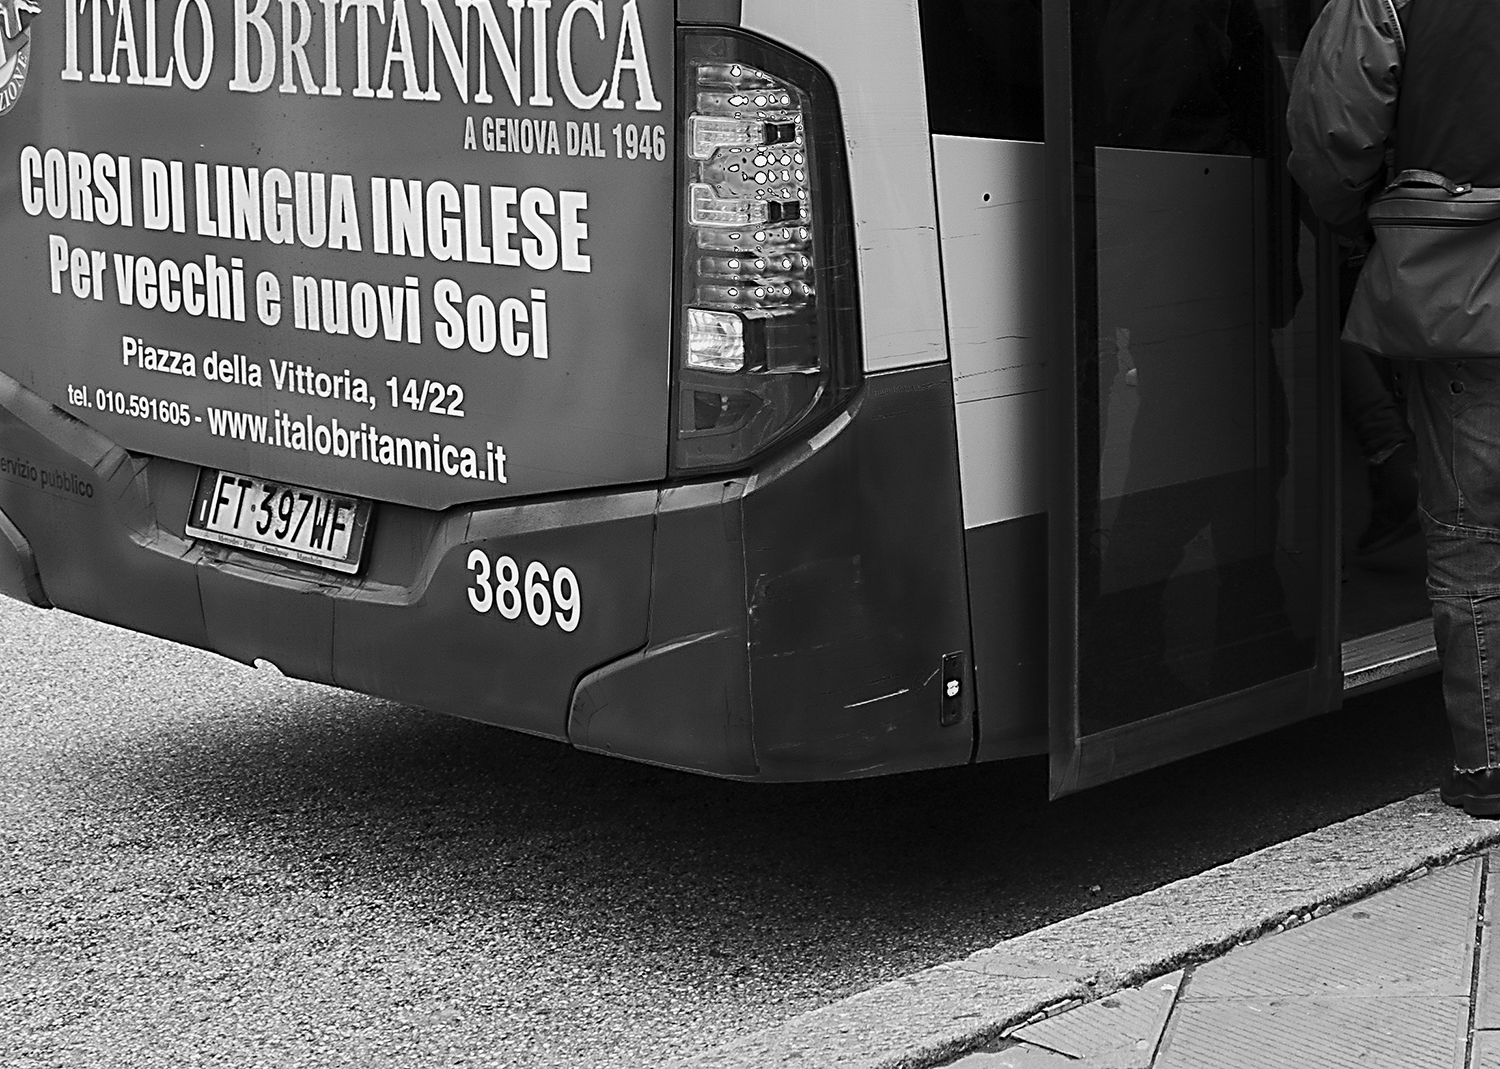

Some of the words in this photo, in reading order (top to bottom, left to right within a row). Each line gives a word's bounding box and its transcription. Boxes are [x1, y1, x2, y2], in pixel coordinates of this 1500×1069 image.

[463, 116, 478, 151] A
[482, 117, 561, 157] GENOVA
[567, 122, 606, 159] DAL
[612, 123, 666, 161] 1946
[19, 145, 133, 228] CORSI
[142, 157, 185, 233] DI
[195, 163, 362, 251] LINGUA
[371, 176, 591, 273] INGLESE
[48, 234, 107, 301] Per
[113, 250, 246, 323] vecchi
[256, 269, 283, 326] e
[293, 274, 421, 345] nuovi
[433, 278, 549, 359] Soci
[121, 336, 196, 379] Piazza
[202, 346, 263, 388] della
[270, 358, 378, 410] Vittoria,
[385, 376, 466, 419] 14/22
[67, 384, 91, 409] tel.
[95, 388, 191, 427] 010.591605
[207, 406, 509, 485] www.italobritannica.it
[41, 469, 94, 499] pubblico
[466, 548, 581, 632] 3869
